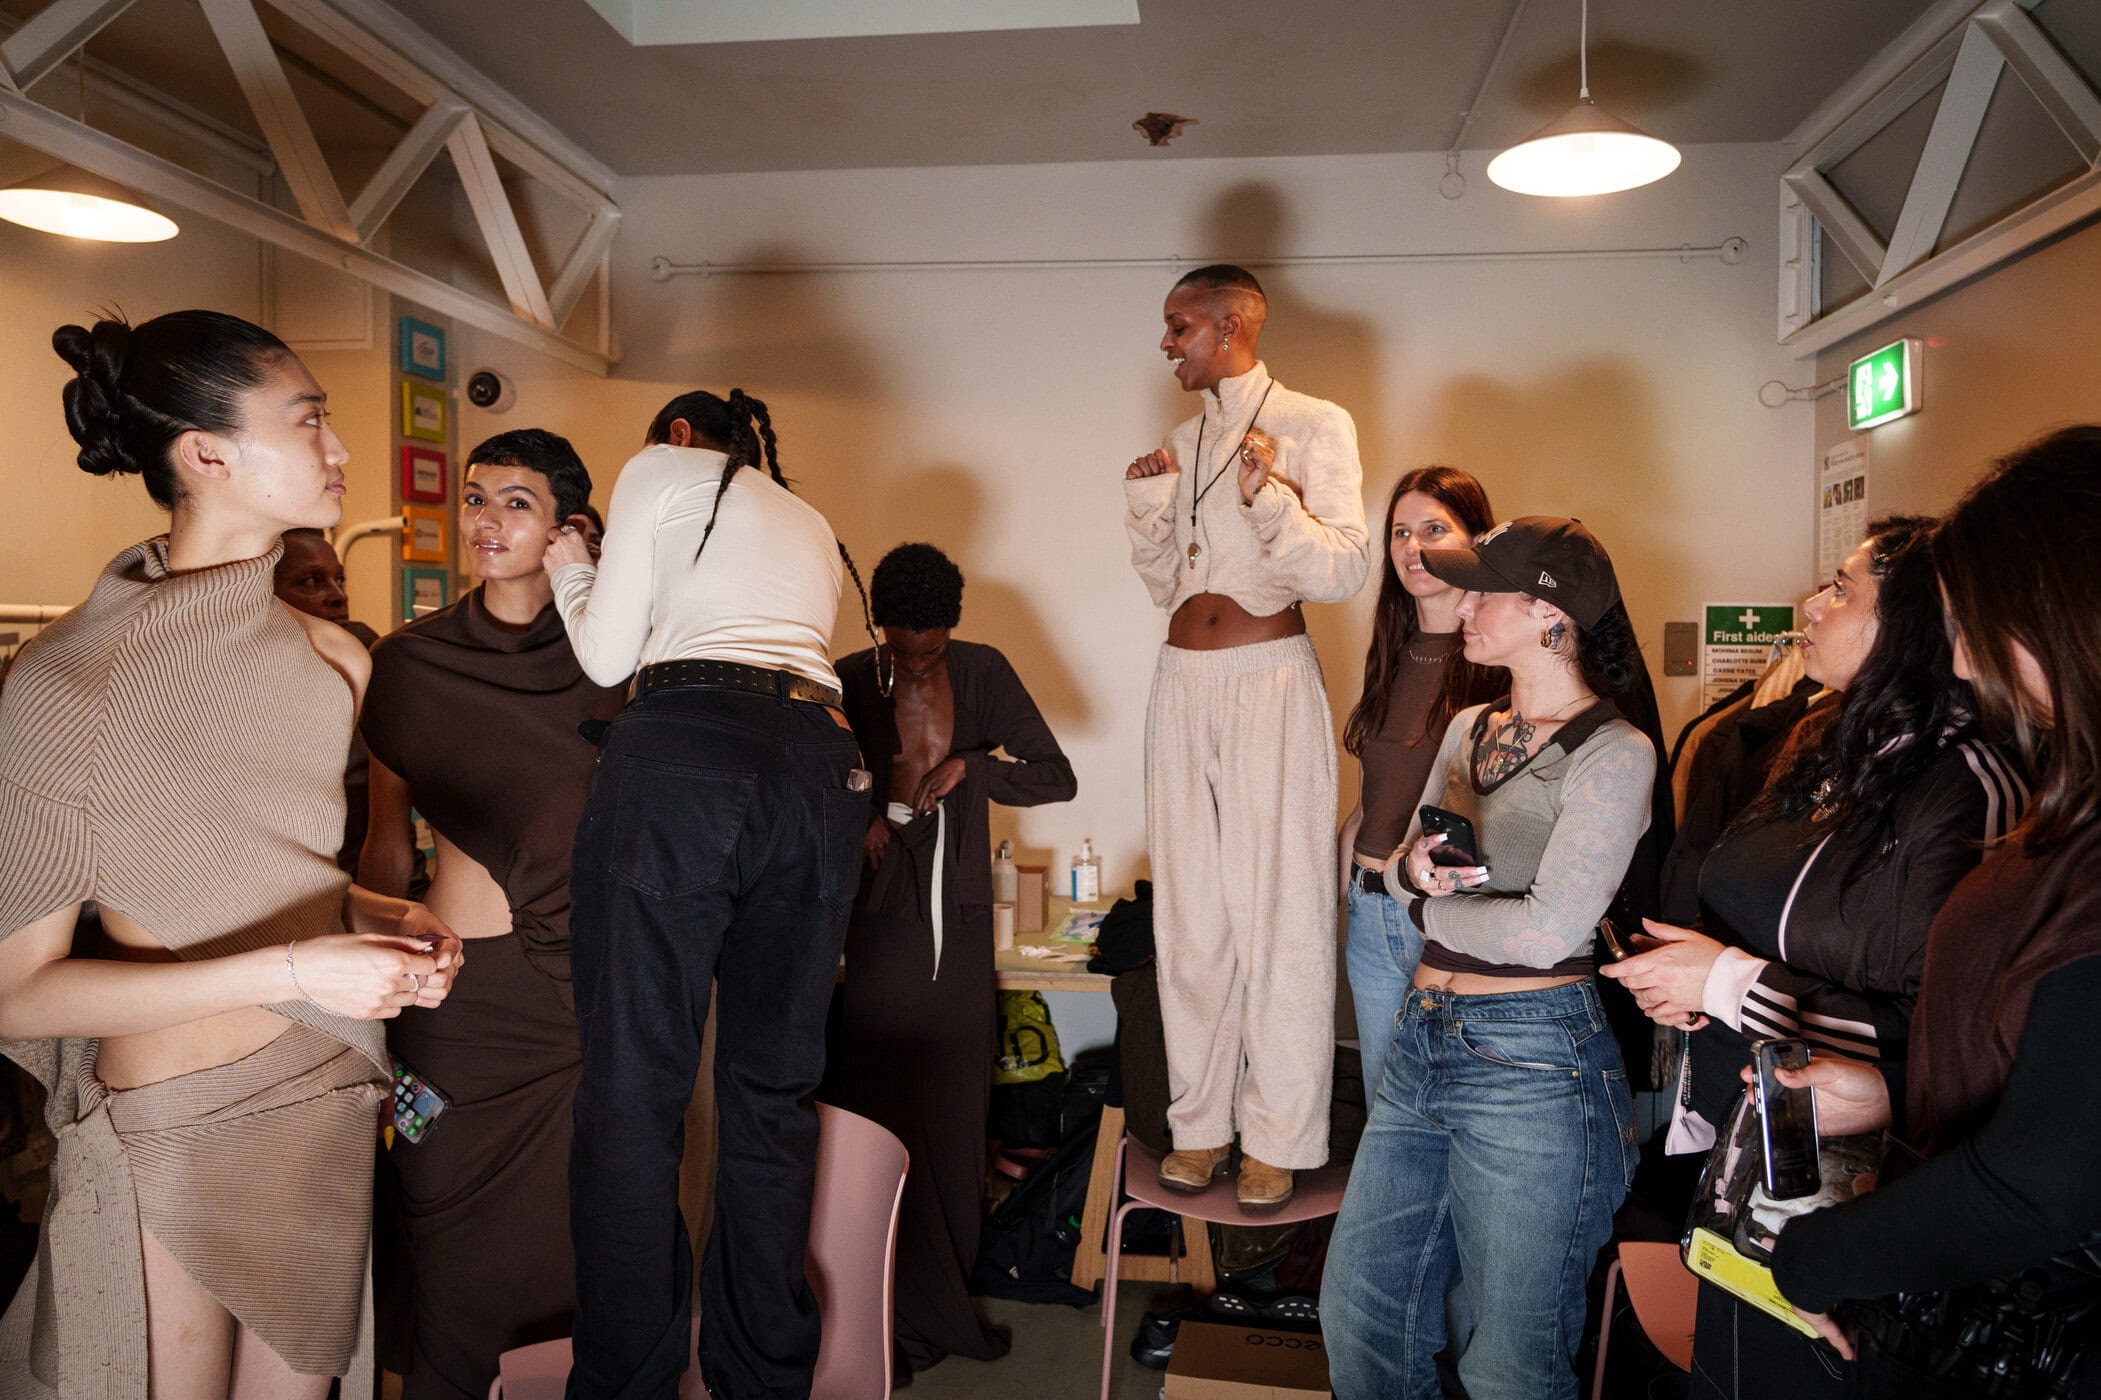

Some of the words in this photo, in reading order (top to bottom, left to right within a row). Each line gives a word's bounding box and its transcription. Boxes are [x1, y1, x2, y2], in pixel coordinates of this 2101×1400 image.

[1713, 630, 1743, 642] First
[1746, 631, 1778, 643] aider
[1244, 1334, 1322, 1351] ecco
